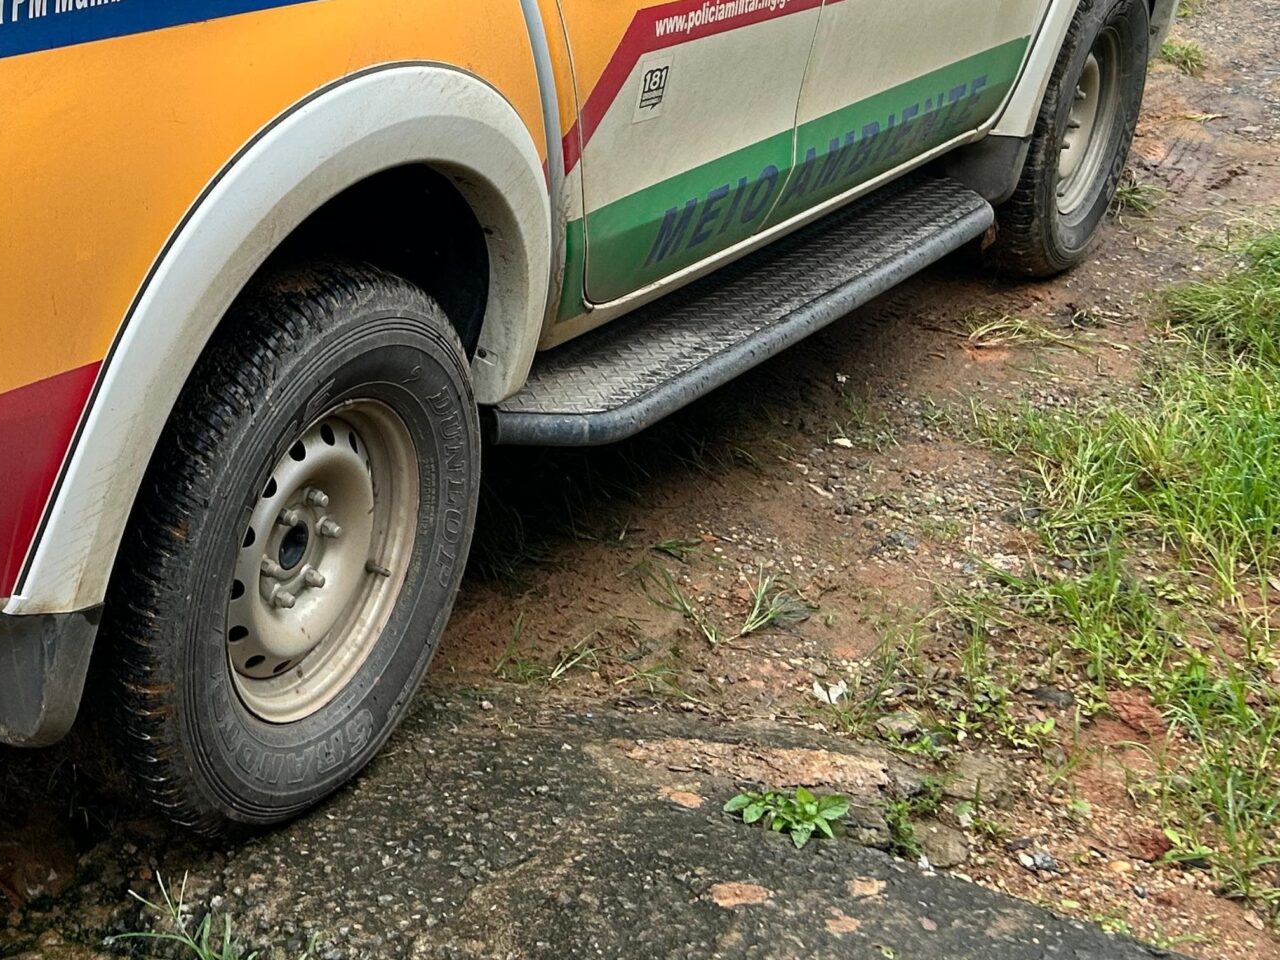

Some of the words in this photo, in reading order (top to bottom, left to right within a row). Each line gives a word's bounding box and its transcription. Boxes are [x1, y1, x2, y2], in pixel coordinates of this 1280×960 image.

[642, 164, 779, 269] MEIO
[780, 74, 989, 207] AMBIENTE
[643, 68, 668, 92] 181
[425, 384, 465, 589] DUNLOP
